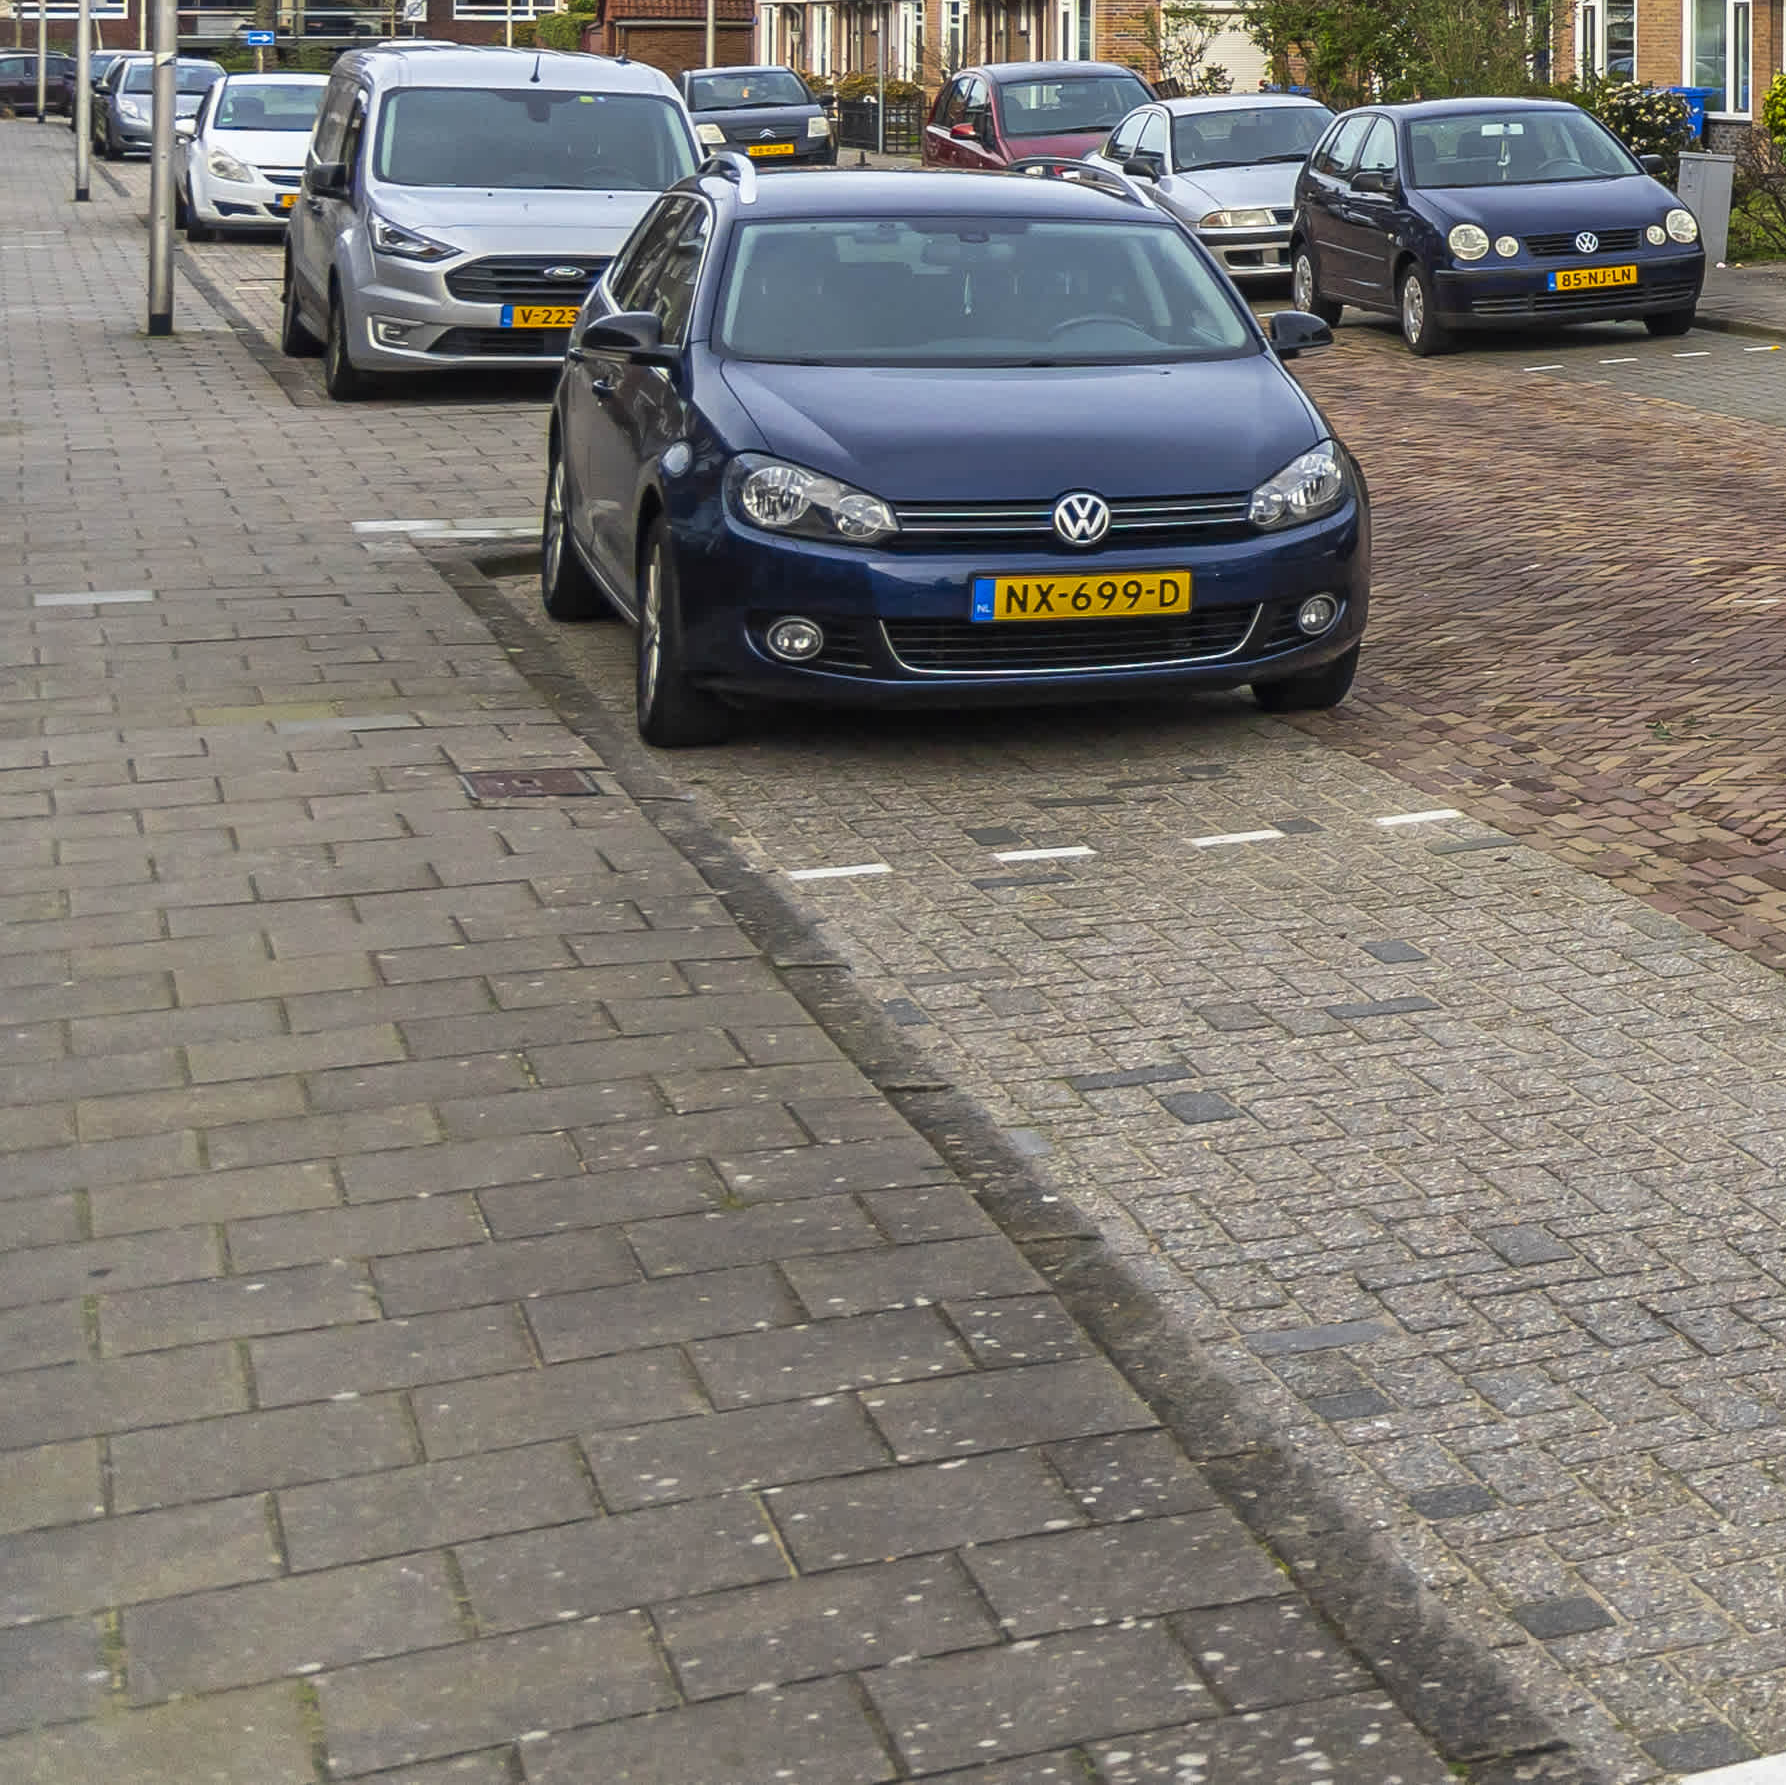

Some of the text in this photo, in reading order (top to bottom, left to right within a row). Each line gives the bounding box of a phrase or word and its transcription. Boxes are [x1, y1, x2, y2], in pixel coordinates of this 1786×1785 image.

[1562, 268, 1631, 287] 85-NJ-LN
[1006, 579, 1180, 613] NX-699-D
[976, 604, 991, 613] NL
